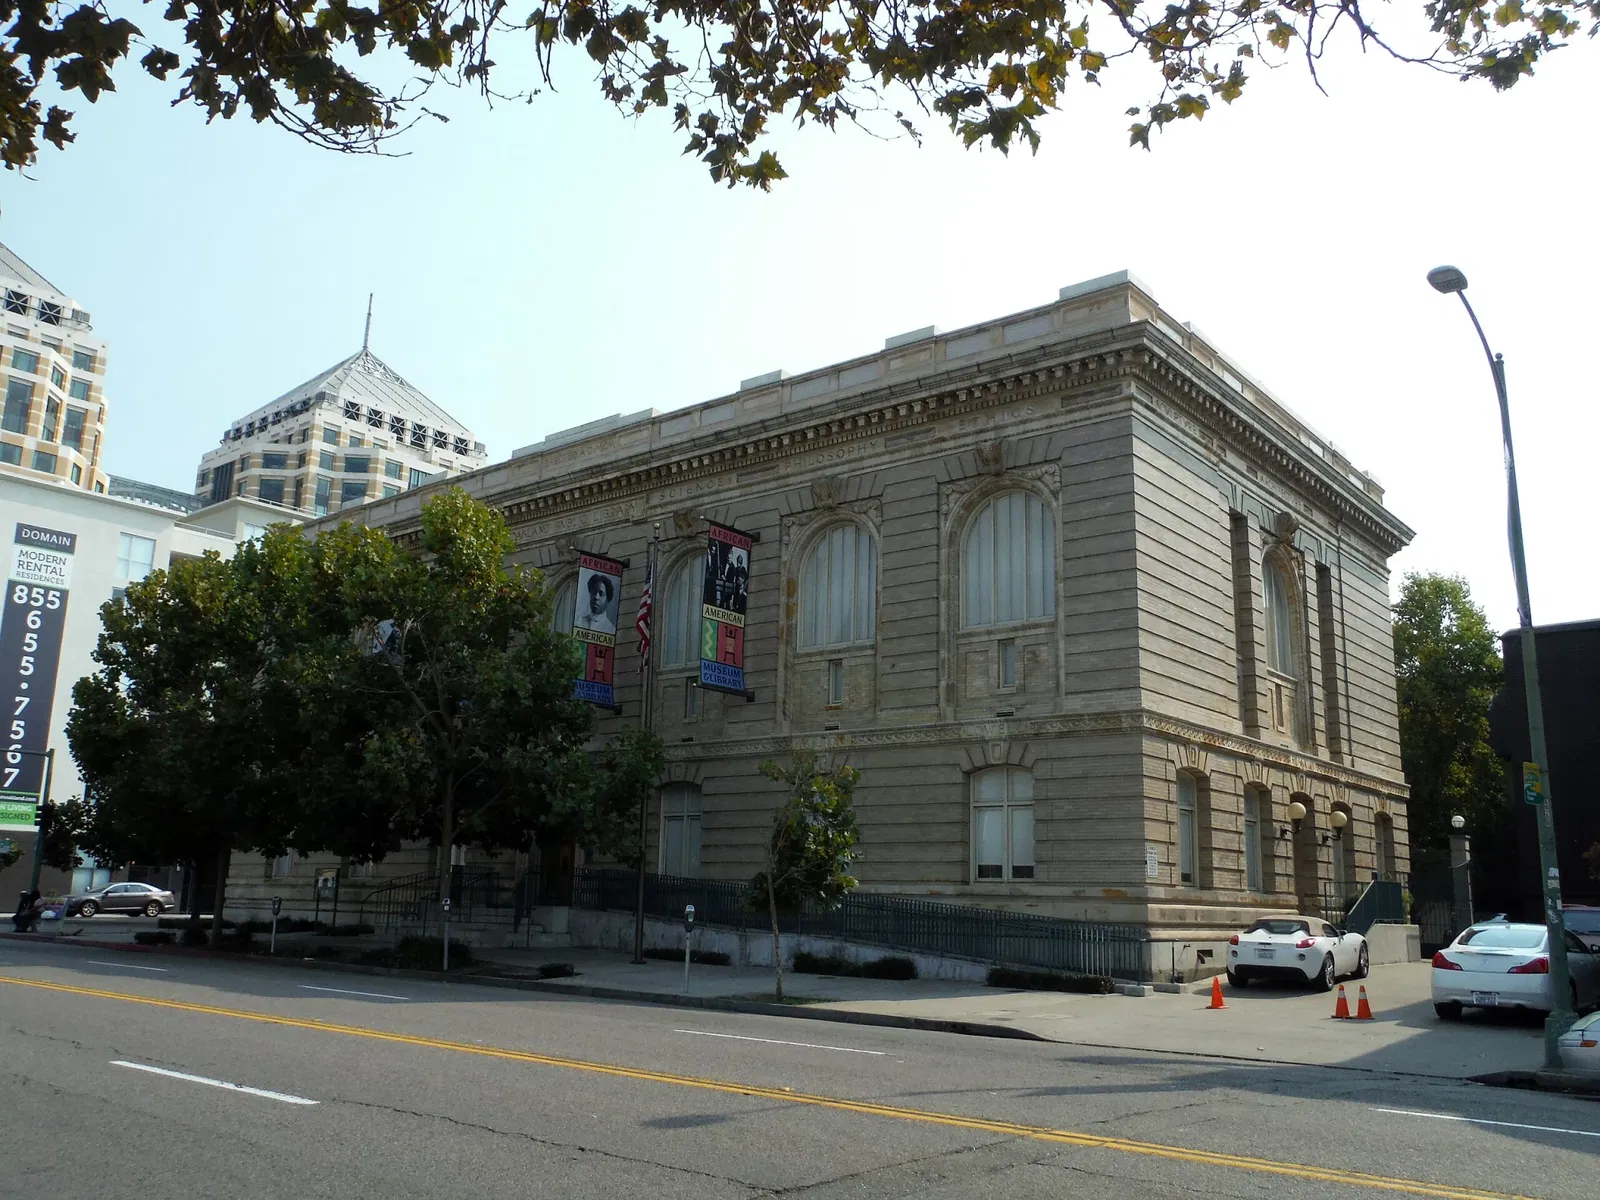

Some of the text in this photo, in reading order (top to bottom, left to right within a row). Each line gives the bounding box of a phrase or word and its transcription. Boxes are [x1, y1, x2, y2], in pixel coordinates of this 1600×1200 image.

[784, 440, 877, 474] PHILOSOPHY
[659, 478, 724, 501] SCIENCE
[22, 528, 70, 546] DOMAIN
[711, 528, 751, 548] AFRICAN
[18, 549, 67, 566] MODERN
[581, 557, 621, 574] AFRICAN
[17, 559, 66, 578] RENTAL
[16, 570, 65, 585] RESIDENCES
[13, 585, 61, 610] 855
[704, 608, 743, 625] AMERICAN
[576, 630, 613, 645] AMERICAN
[702, 662, 741, 679] MUSEUM
